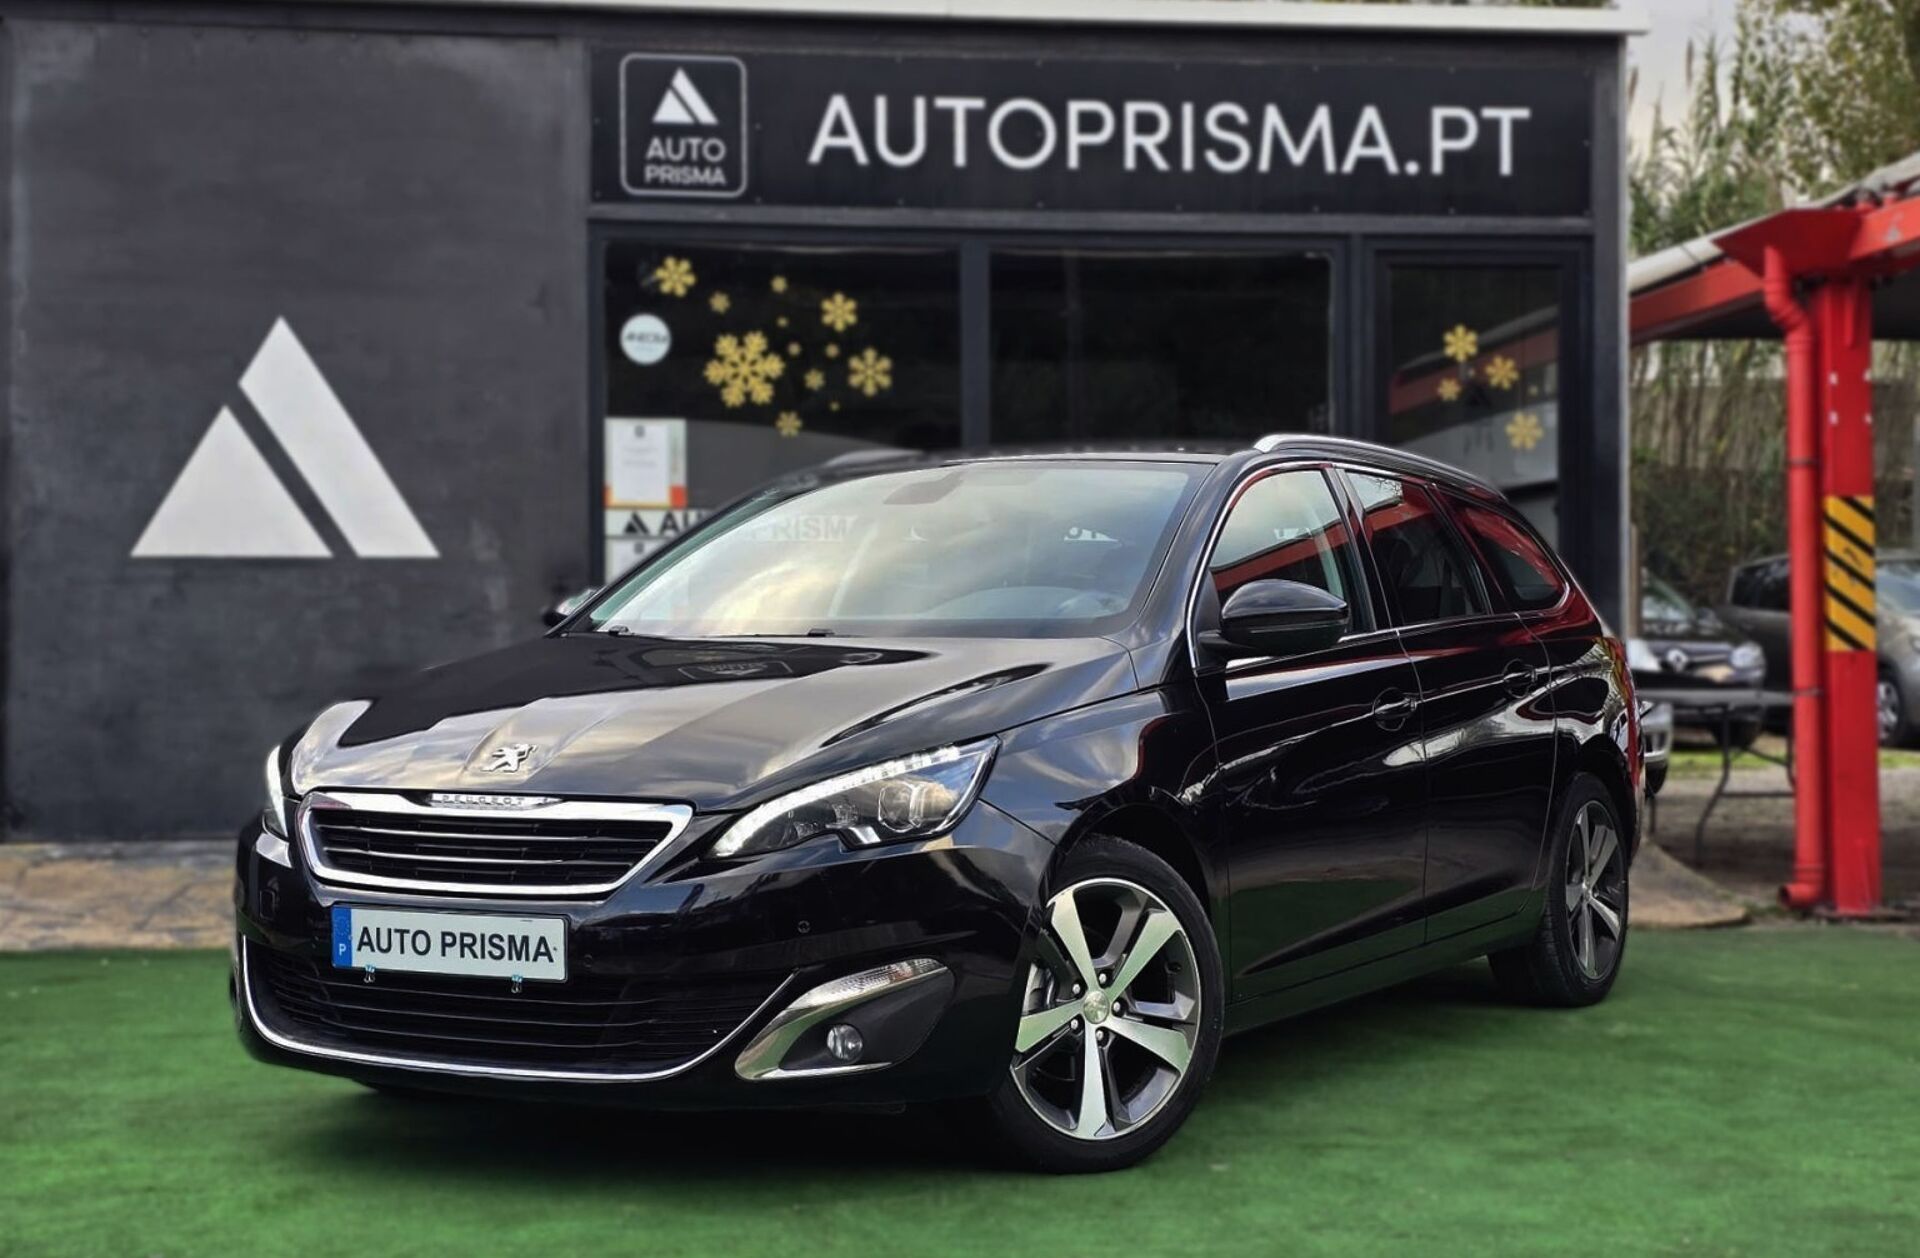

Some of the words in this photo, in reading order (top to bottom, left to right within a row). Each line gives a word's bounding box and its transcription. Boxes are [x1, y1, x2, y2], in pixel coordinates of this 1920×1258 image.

[807, 95, 1531, 177] AUTOPRISMA.PT
[646, 136, 727, 163] AUTO
[644, 164, 727, 186] PRISMA
[442, 794, 525, 806] PEUGEOT
[338, 943, 347, 956] P
[356, 926, 432, 956] AUTO
[440, 931, 555, 964] PRISMA
